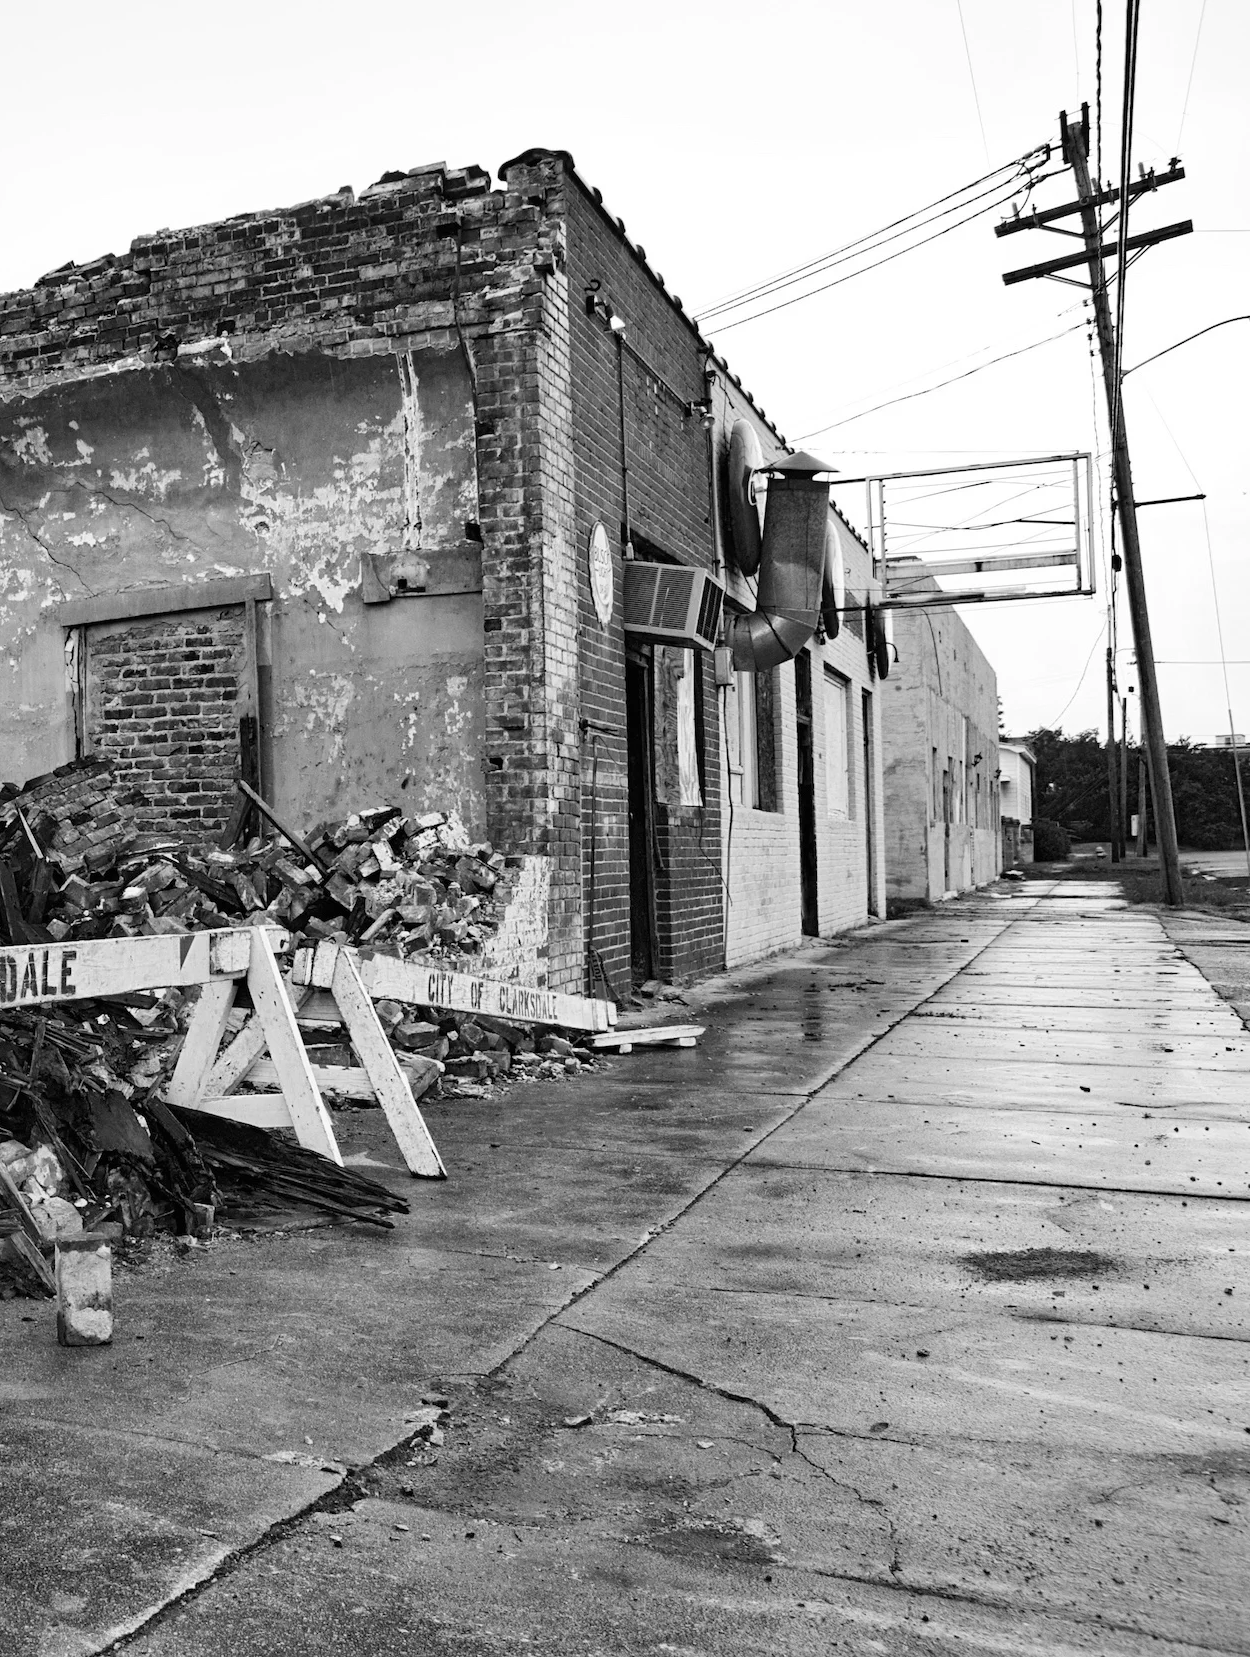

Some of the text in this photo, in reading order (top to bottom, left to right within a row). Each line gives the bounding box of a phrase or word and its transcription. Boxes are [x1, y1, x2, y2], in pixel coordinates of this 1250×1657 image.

[428, 973, 558, 1020] CITY OF CLARKSDALE
